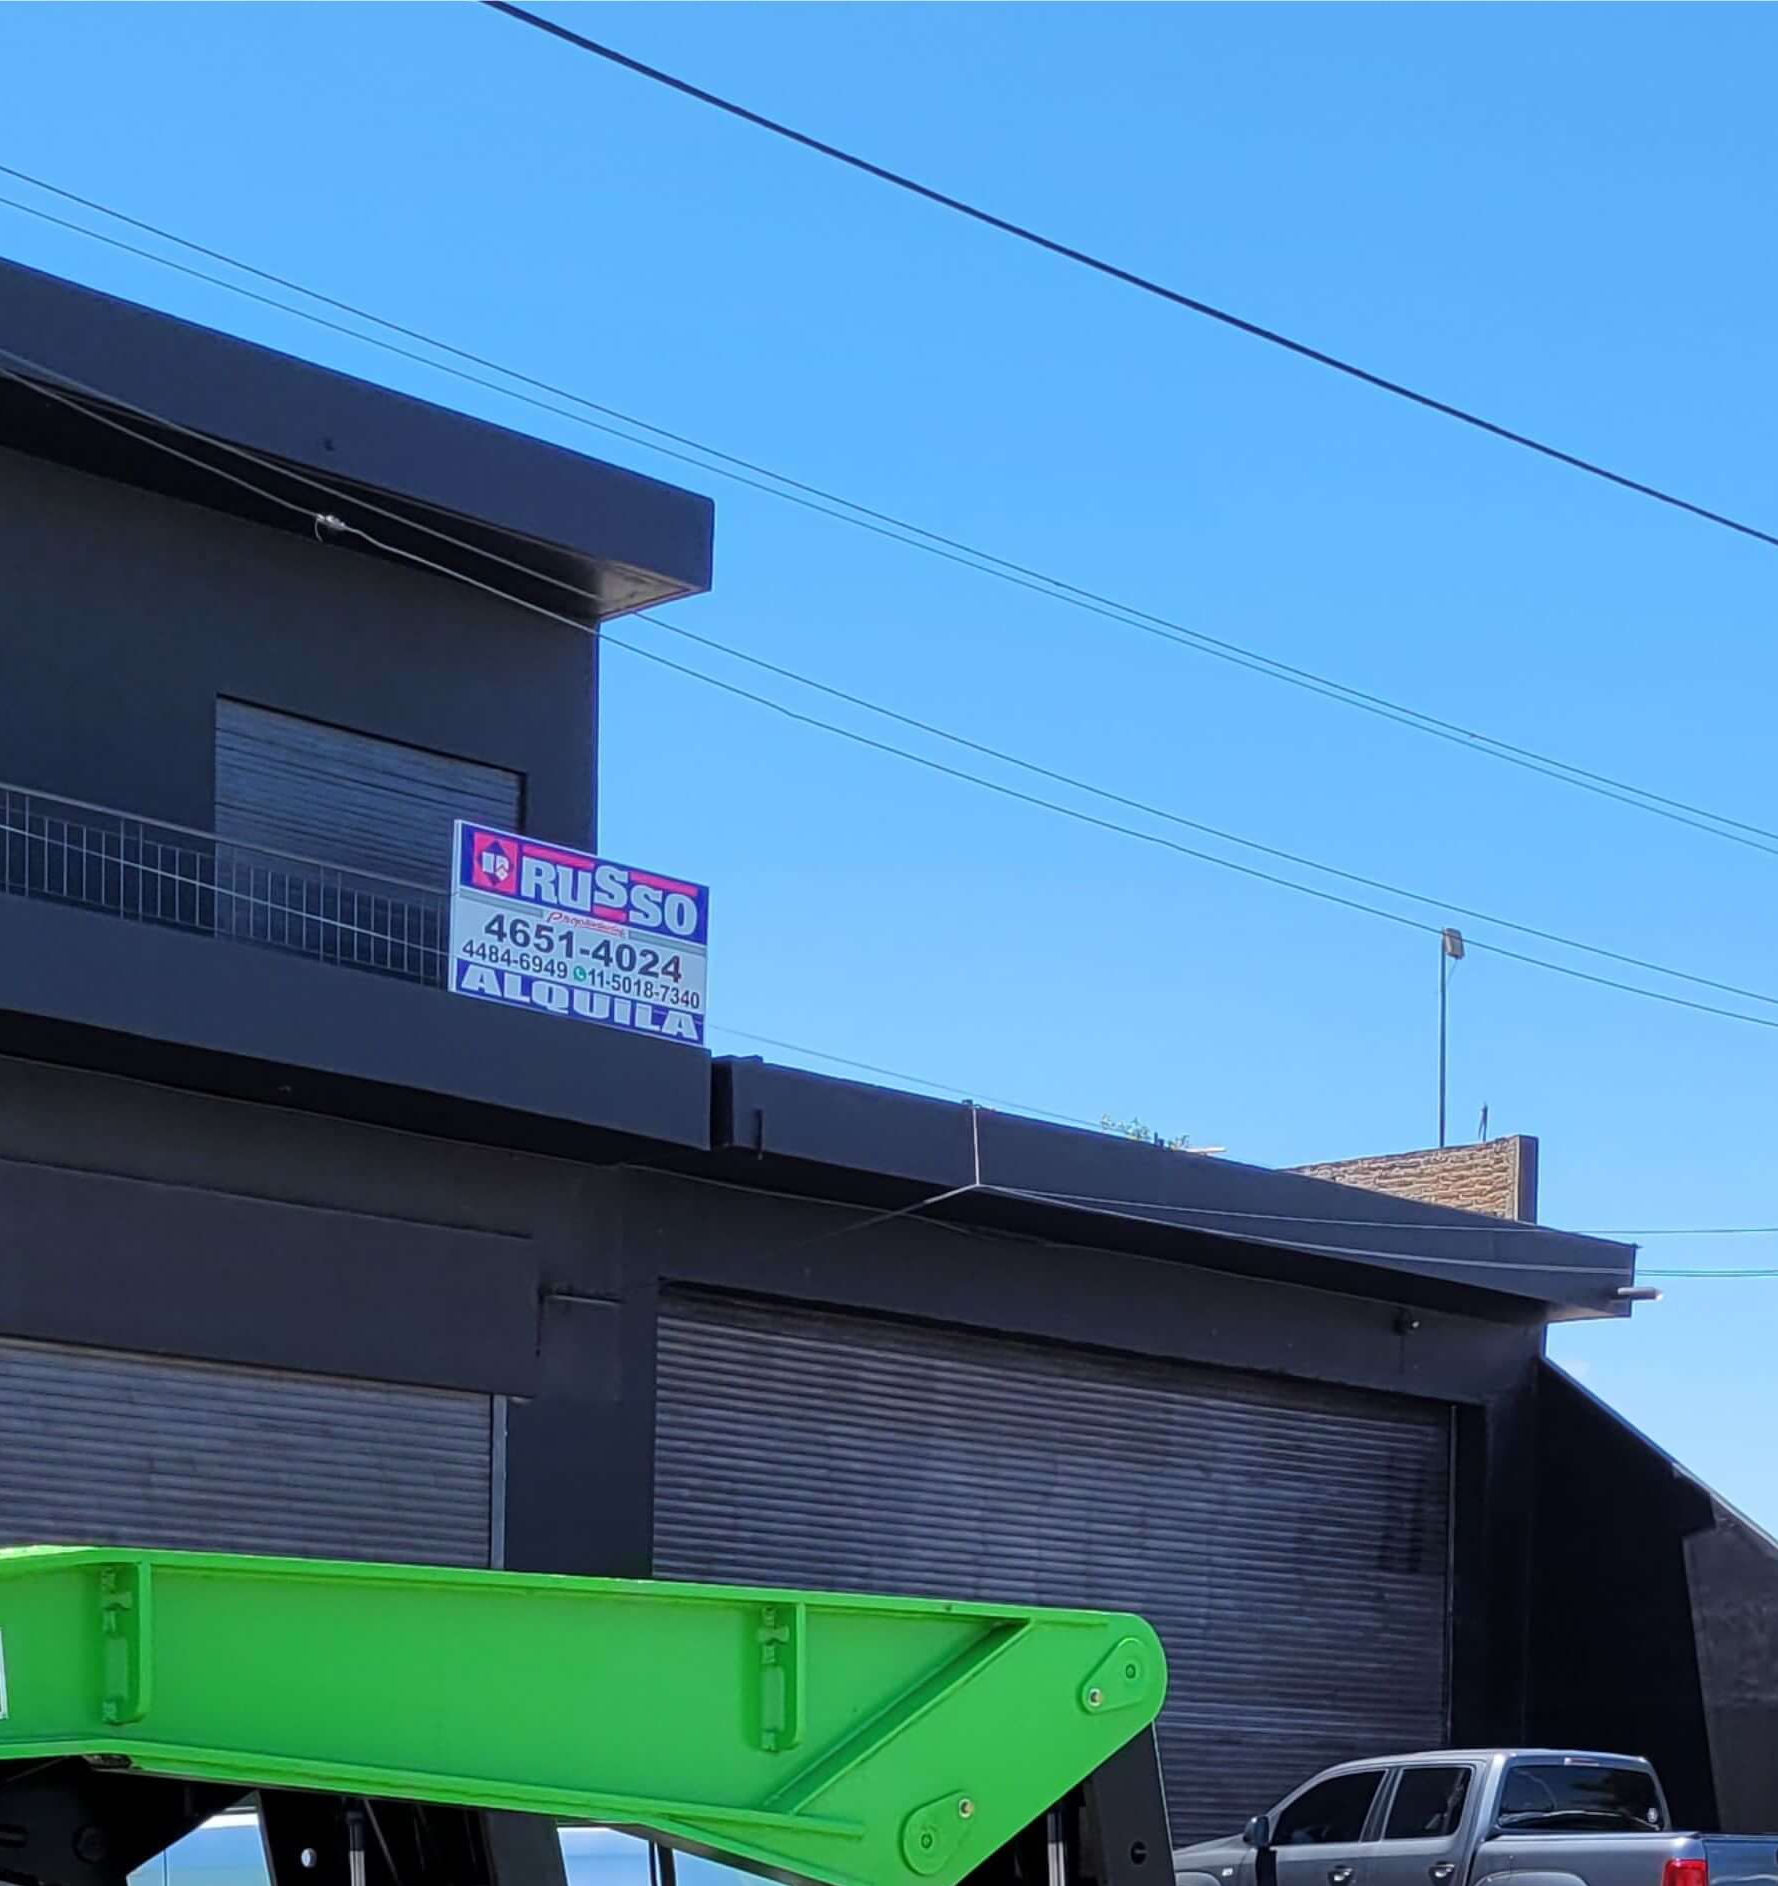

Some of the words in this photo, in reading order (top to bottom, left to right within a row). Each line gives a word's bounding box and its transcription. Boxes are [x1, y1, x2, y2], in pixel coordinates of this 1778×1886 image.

[521, 855, 698, 936] RUSSO
[462, 939, 568, 979] 4484-6949
[588, 968, 700, 1009] 11-5018-7340
[483, 913, 682, 984] 4651-4024
[460, 964, 700, 1041] ALQUILA
